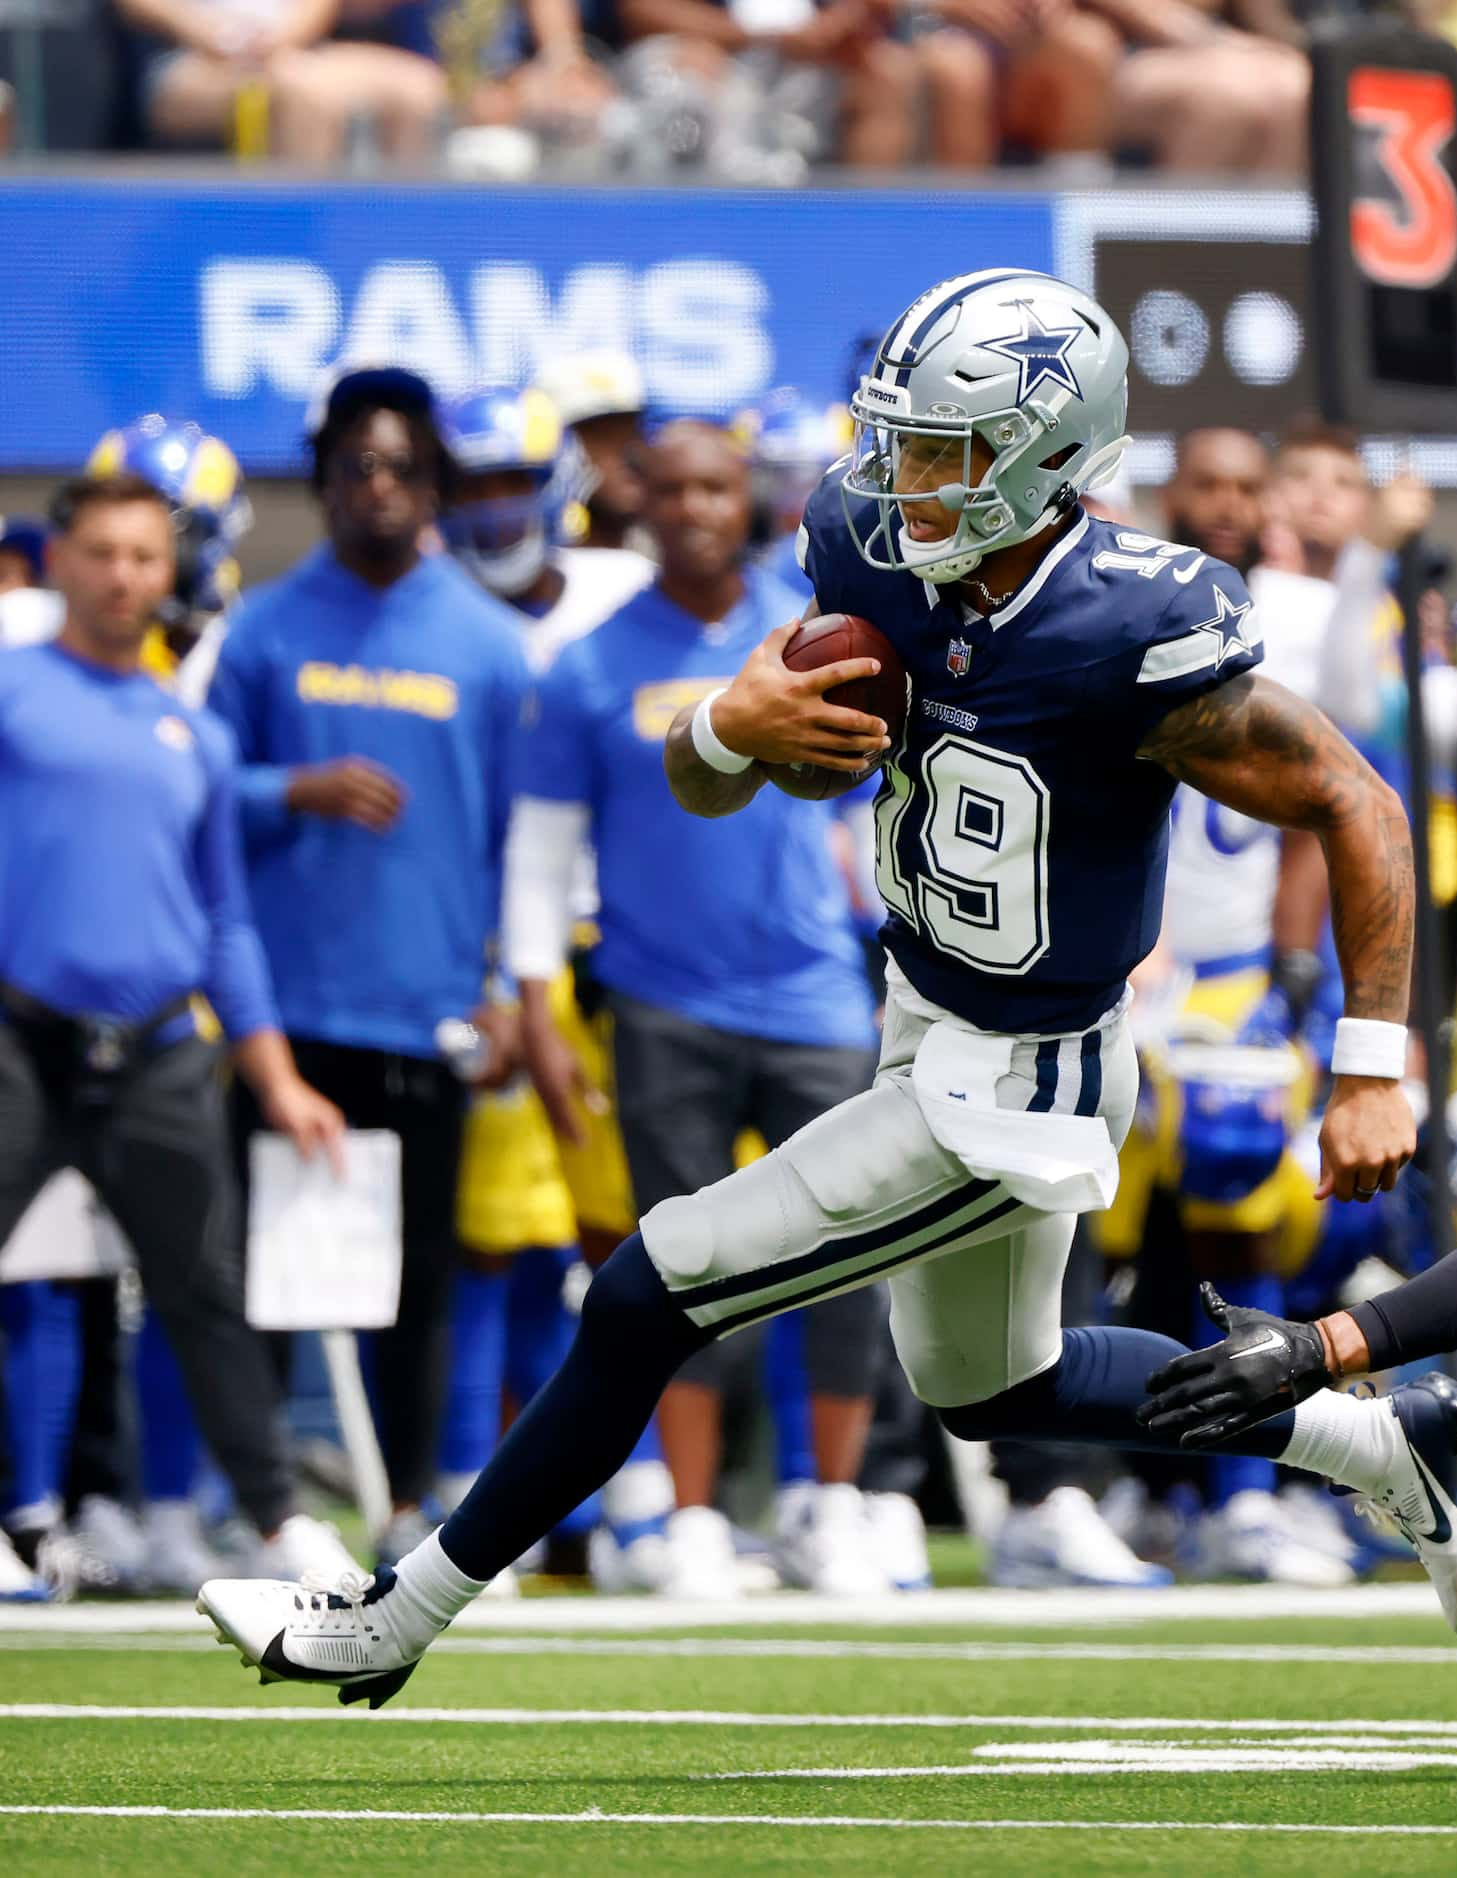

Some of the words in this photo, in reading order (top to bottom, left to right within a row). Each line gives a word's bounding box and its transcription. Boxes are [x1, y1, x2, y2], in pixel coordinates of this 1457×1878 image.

[201, 255, 774, 408] RAMS
[1092, 532, 1200, 579] 19
[922, 698, 979, 732] COWBOYS
[873, 732, 1050, 975] 19
